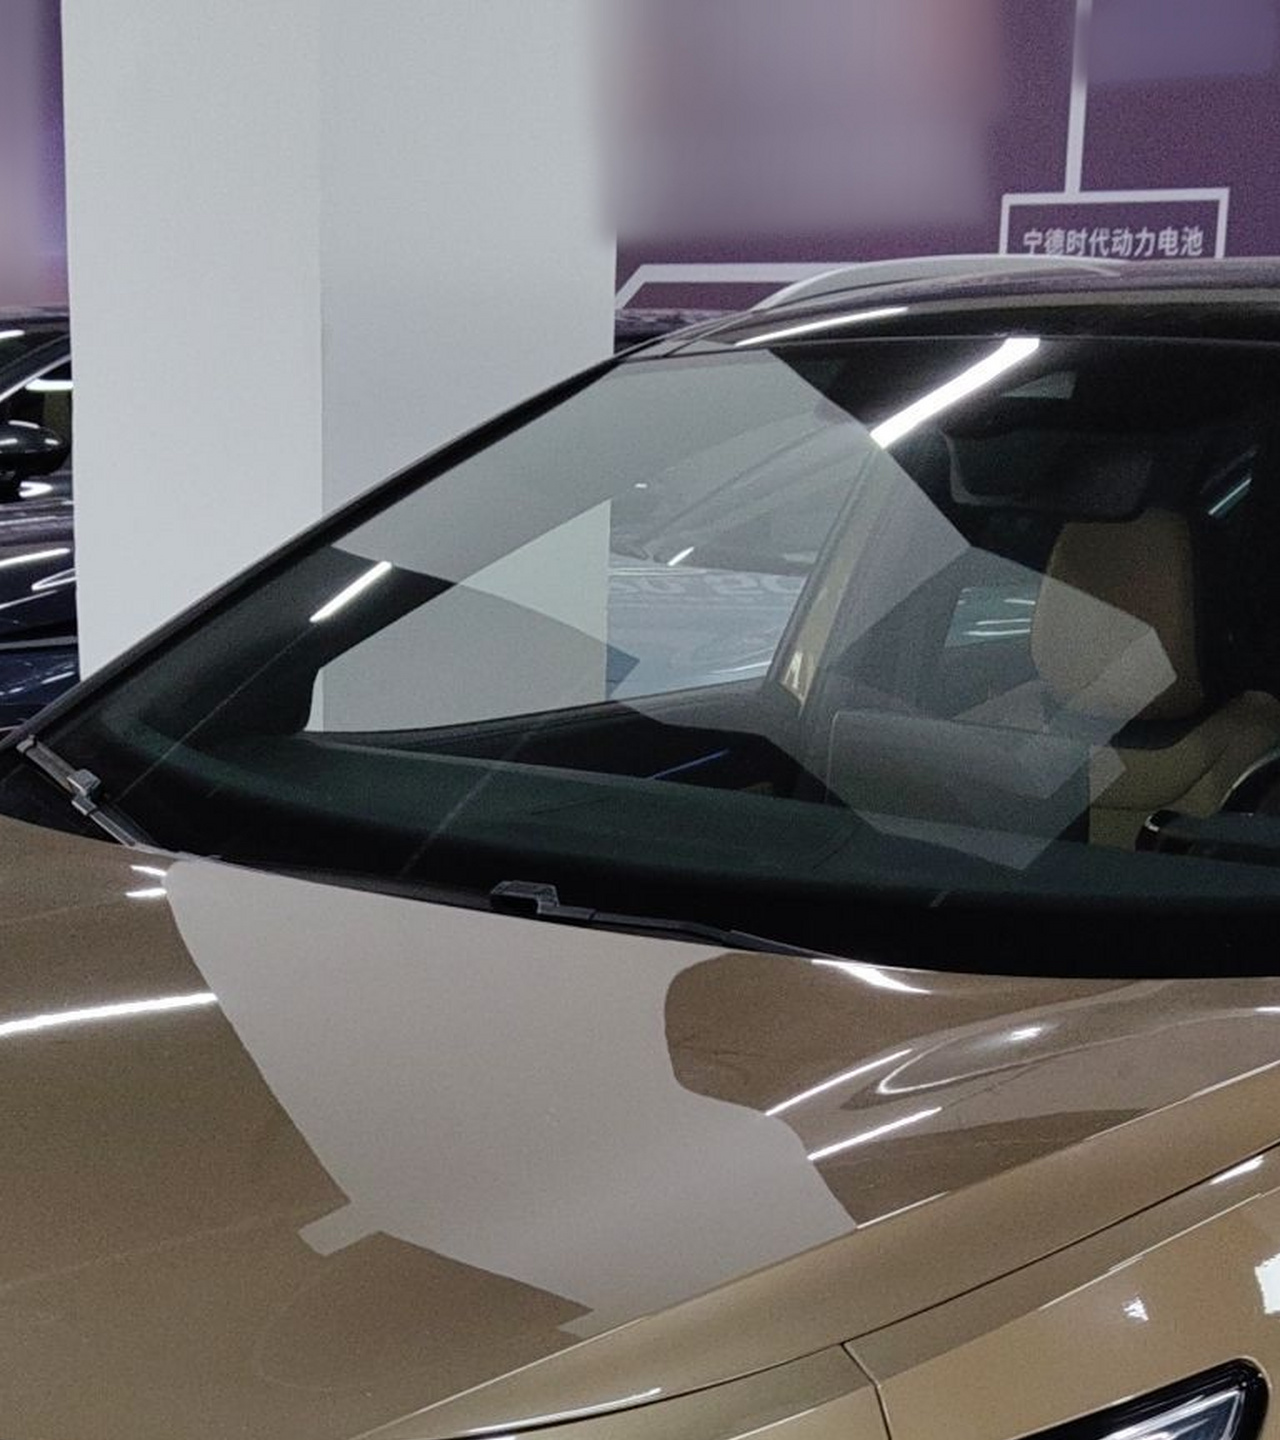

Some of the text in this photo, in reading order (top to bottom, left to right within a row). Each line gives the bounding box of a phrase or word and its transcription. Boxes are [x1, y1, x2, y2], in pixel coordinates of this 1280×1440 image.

[1023, 226, 1205, 258] 宁德时代动力电池
